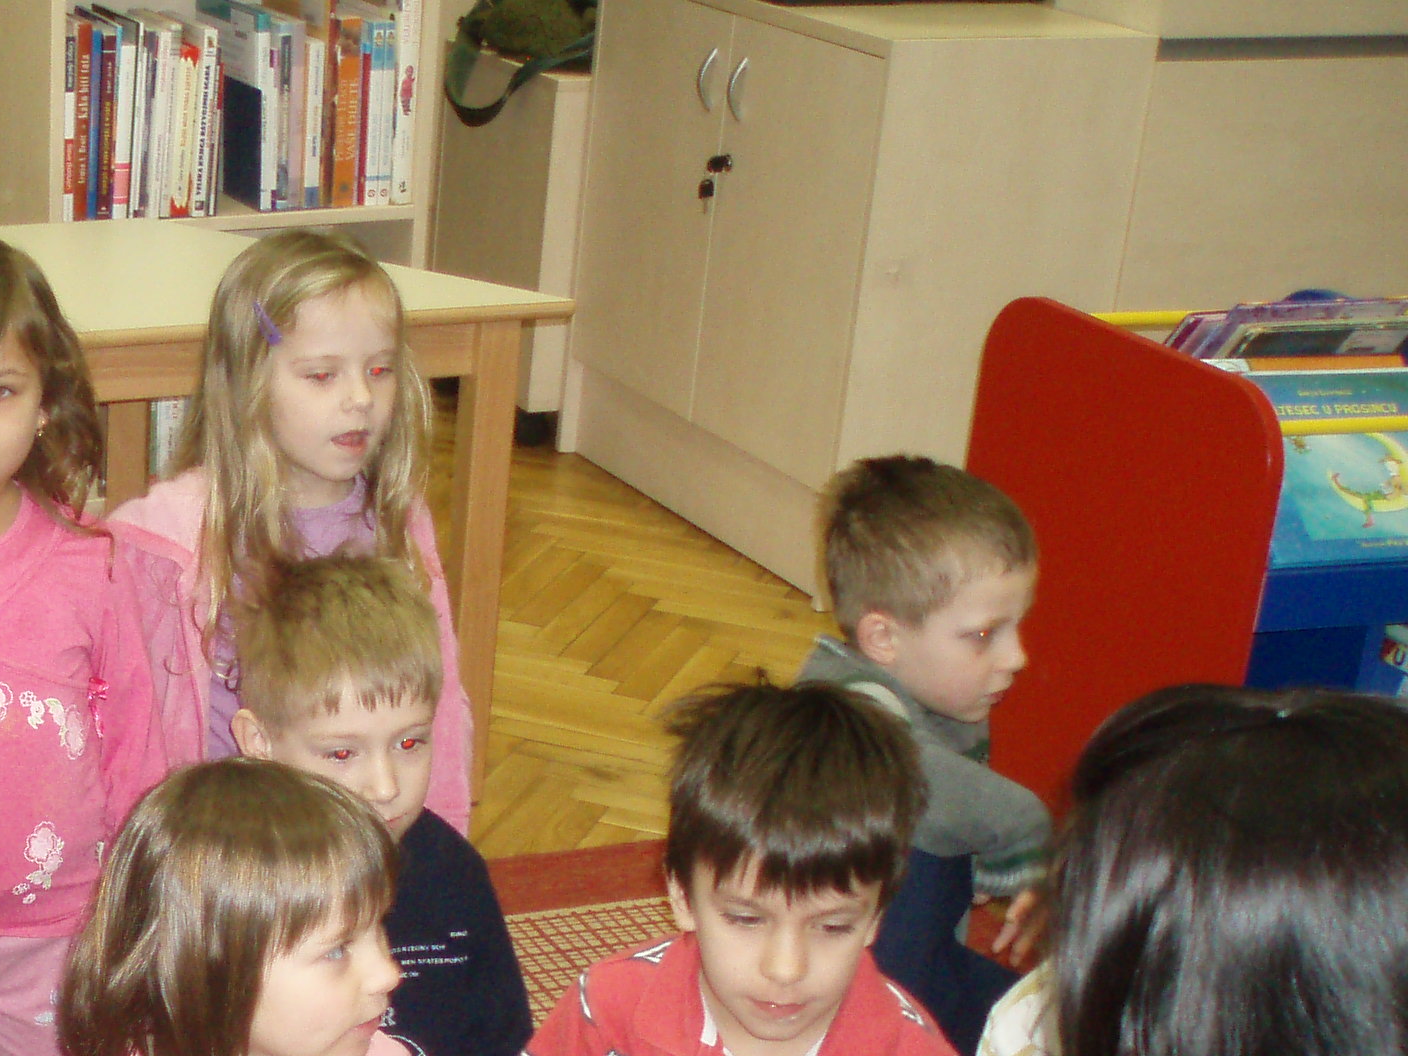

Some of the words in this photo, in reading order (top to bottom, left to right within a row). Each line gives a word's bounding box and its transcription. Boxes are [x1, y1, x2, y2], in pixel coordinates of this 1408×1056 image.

[80, 54, 90, 73] tata
[78, 77, 90, 93] biti
[78, 96, 90, 119] Kako
[197, 138, 206, 166] KNJIGA
[195, 168, 204, 196] VELIKA
[1334, 402, 1399, 415] PROSINCU
